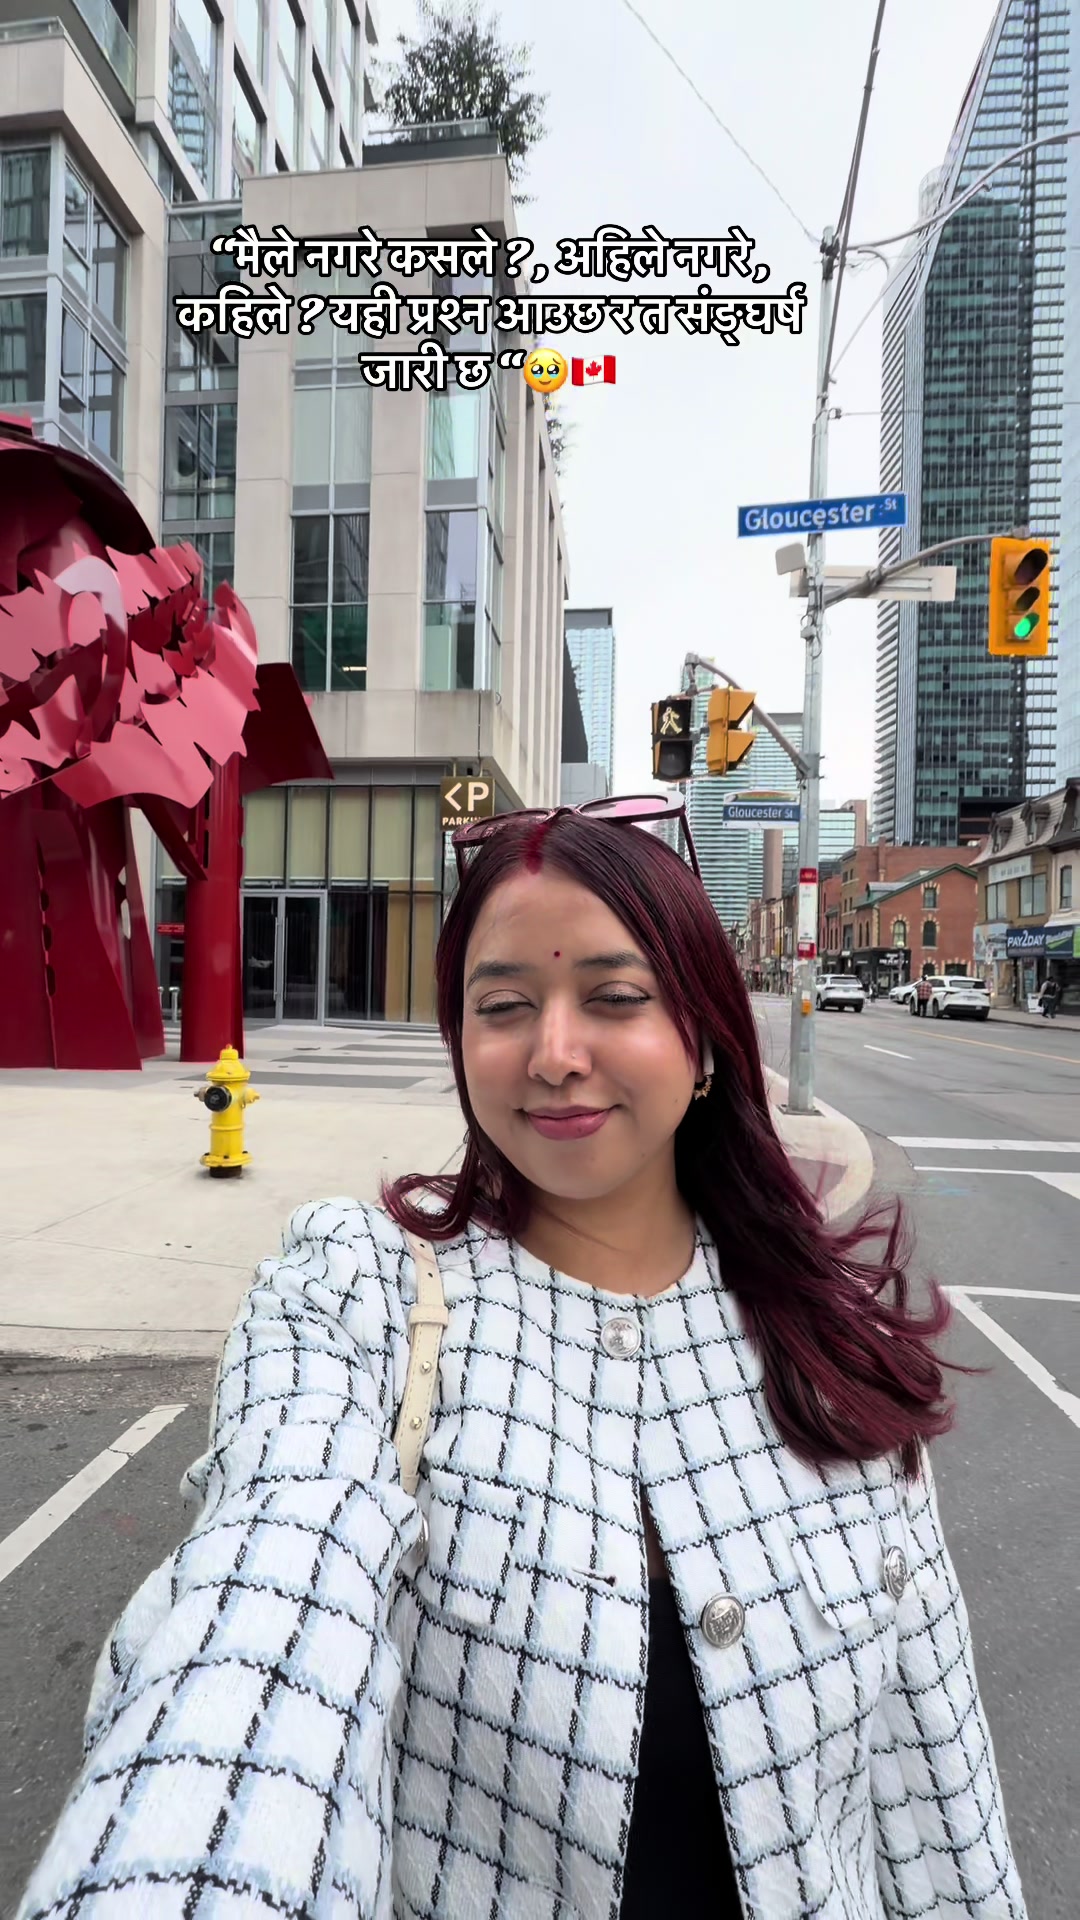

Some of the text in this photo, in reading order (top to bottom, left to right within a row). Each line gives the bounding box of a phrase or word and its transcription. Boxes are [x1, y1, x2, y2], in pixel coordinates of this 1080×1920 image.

[744, 497, 898, 531] Gloucester St
[467, 781, 490, 812] P
[728, 805, 794, 819] Gloucester St
[1007, 929, 1046, 948] PAY2DAY
